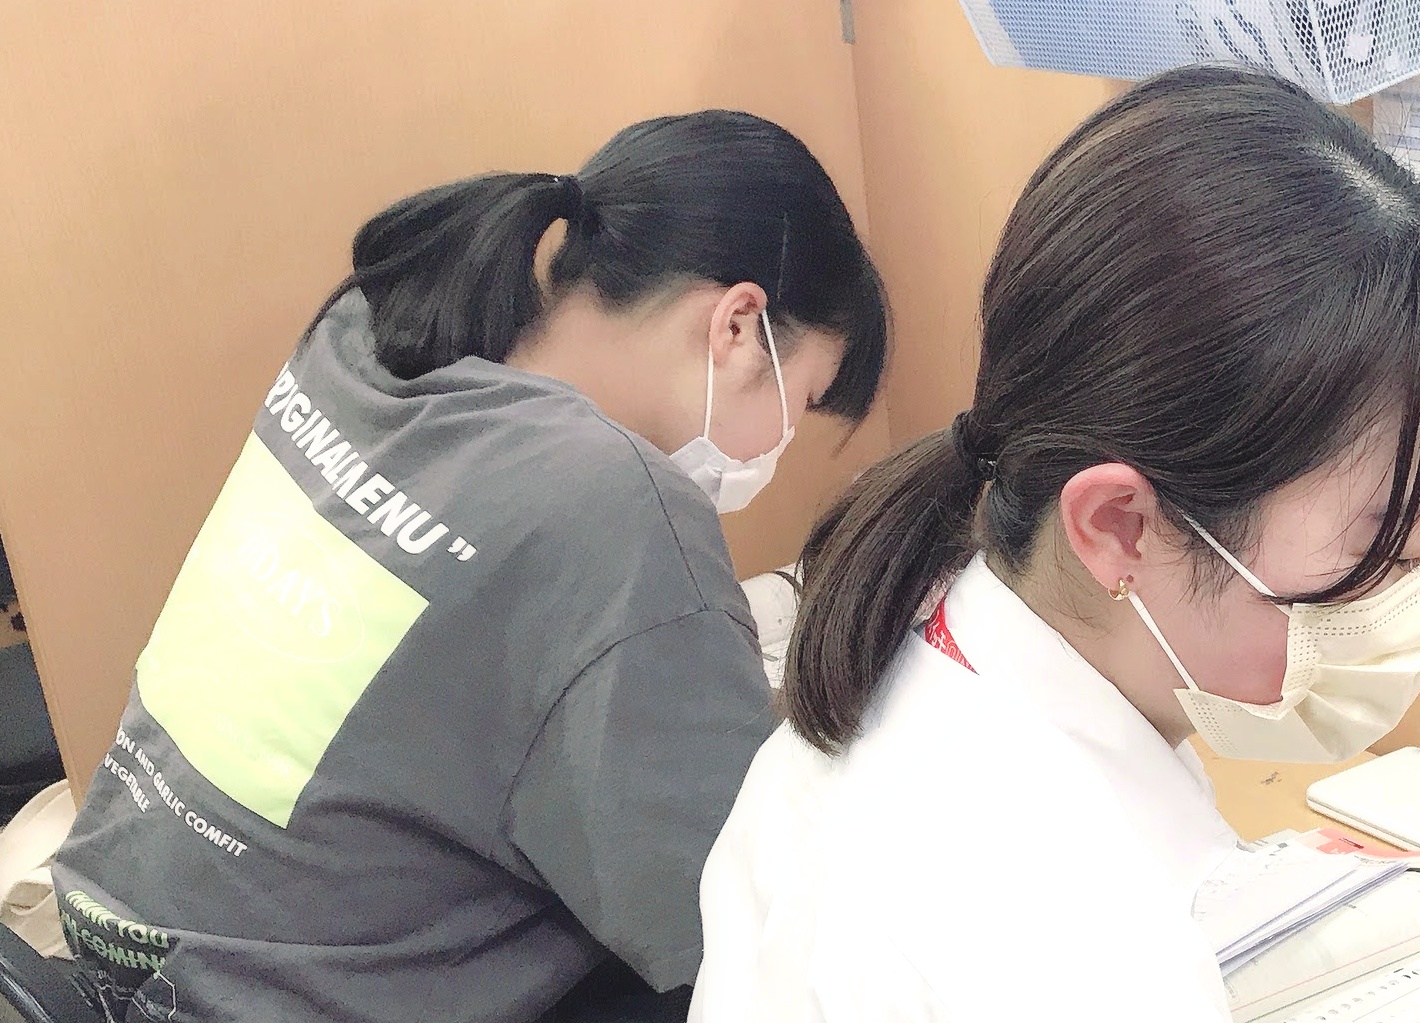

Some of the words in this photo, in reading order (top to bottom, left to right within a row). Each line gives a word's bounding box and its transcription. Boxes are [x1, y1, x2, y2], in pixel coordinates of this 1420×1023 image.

[103, 752, 150, 813] VEGETABLE
[134, 748, 155, 777] AND
[153, 771, 186, 817] GARLIC
[185, 810, 248, 857] COMFIT
